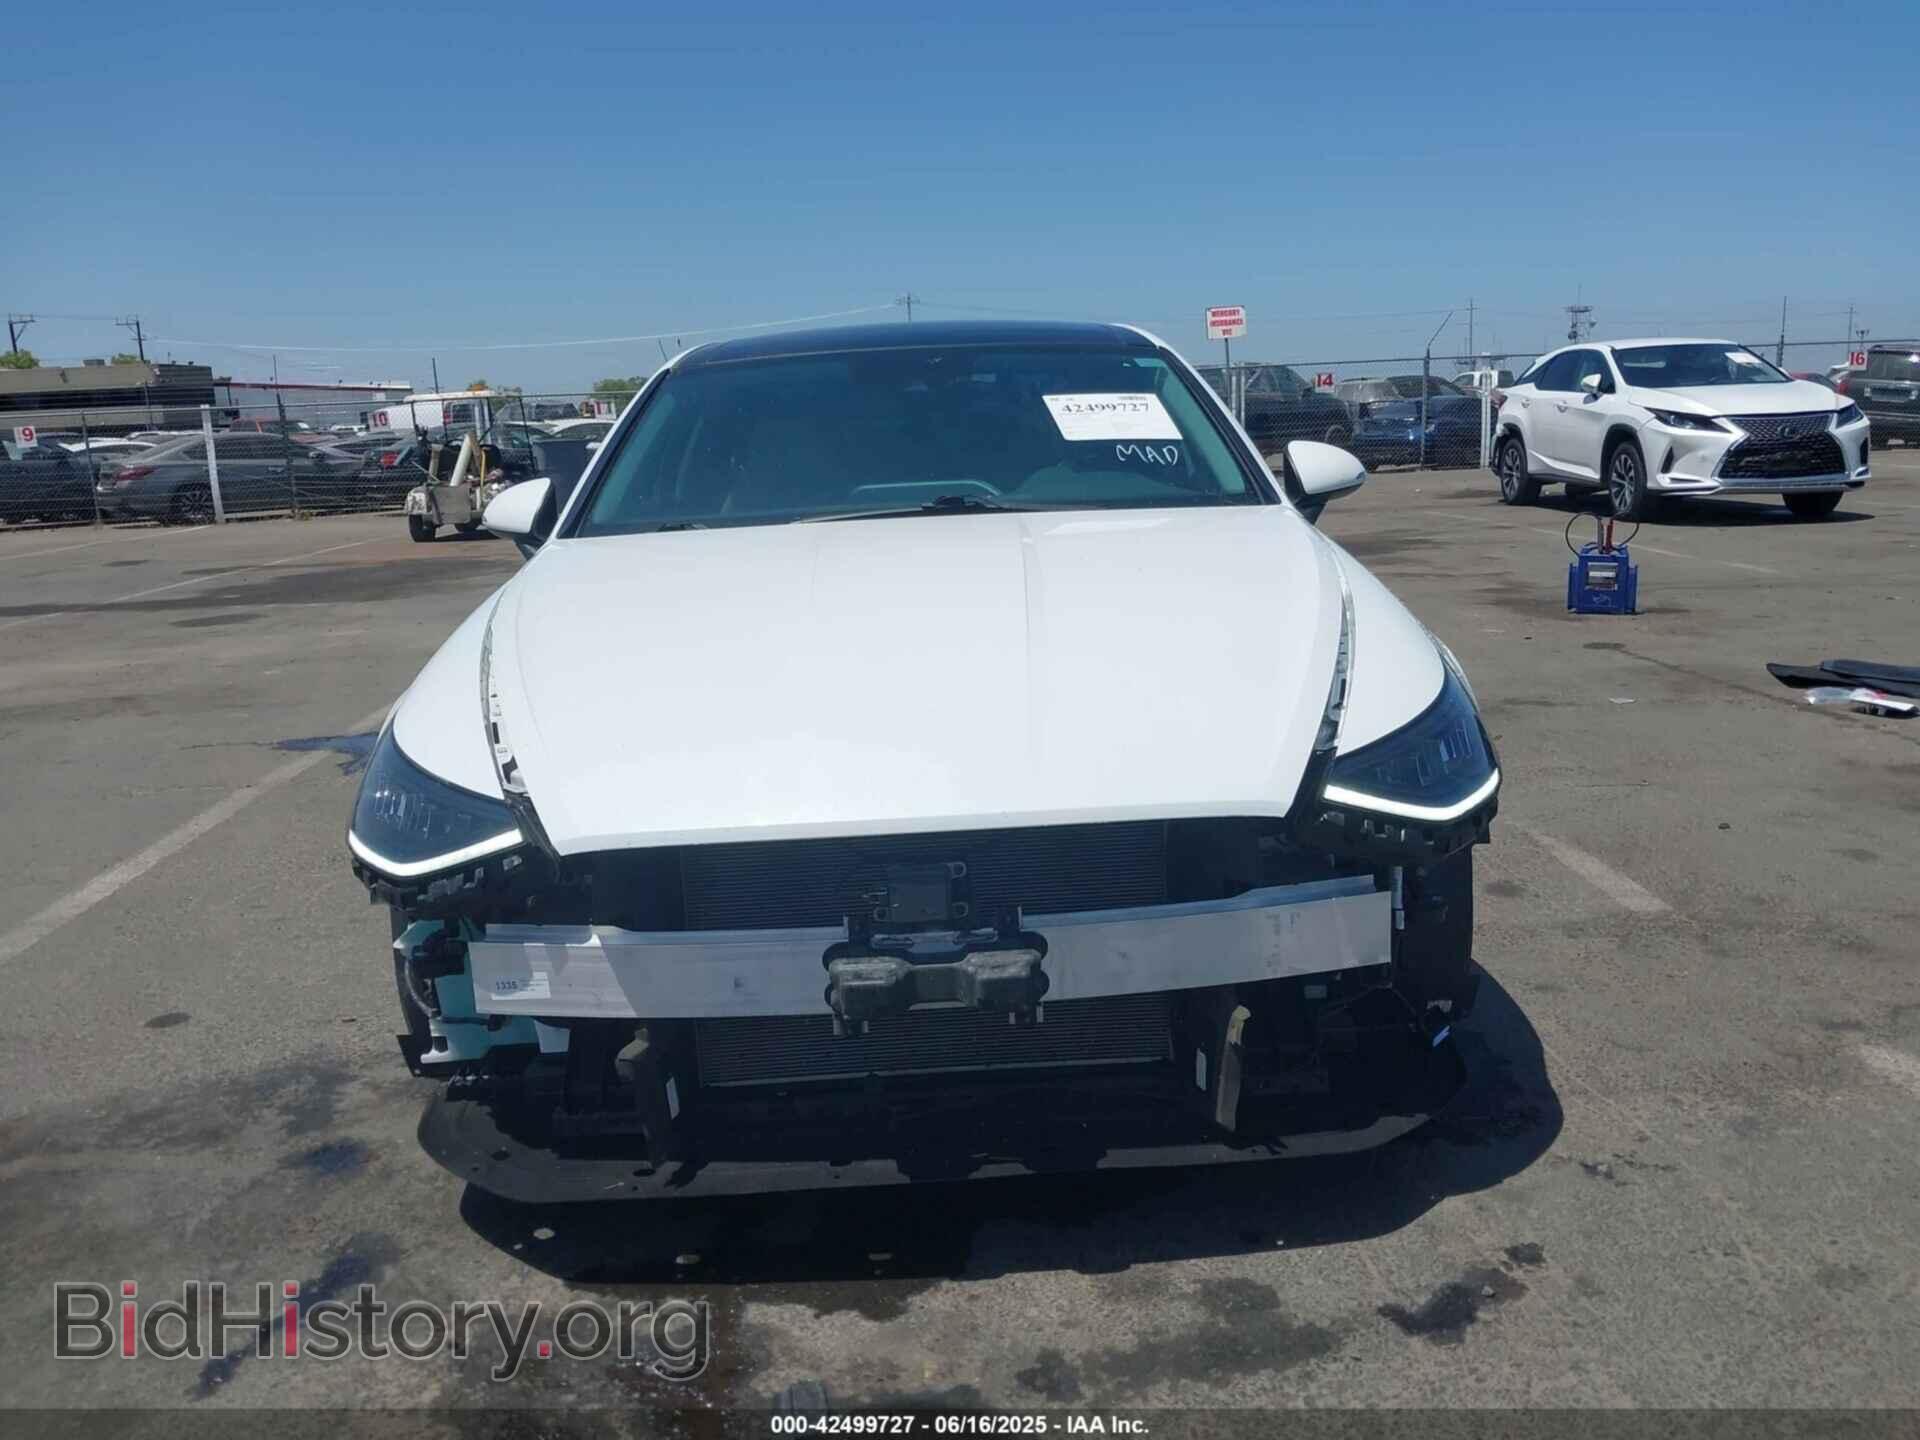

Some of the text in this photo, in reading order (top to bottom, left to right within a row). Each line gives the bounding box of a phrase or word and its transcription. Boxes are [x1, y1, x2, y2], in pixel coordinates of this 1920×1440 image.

[1850, 351, 1865, 366] 16
[1316, 372, 1333, 388] 14
[1062, 402, 1149, 413] 42499727
[372, 411, 388, 427] 10
[22, 427, 33, 441] 9
[1115, 444, 1178, 465] MAD
